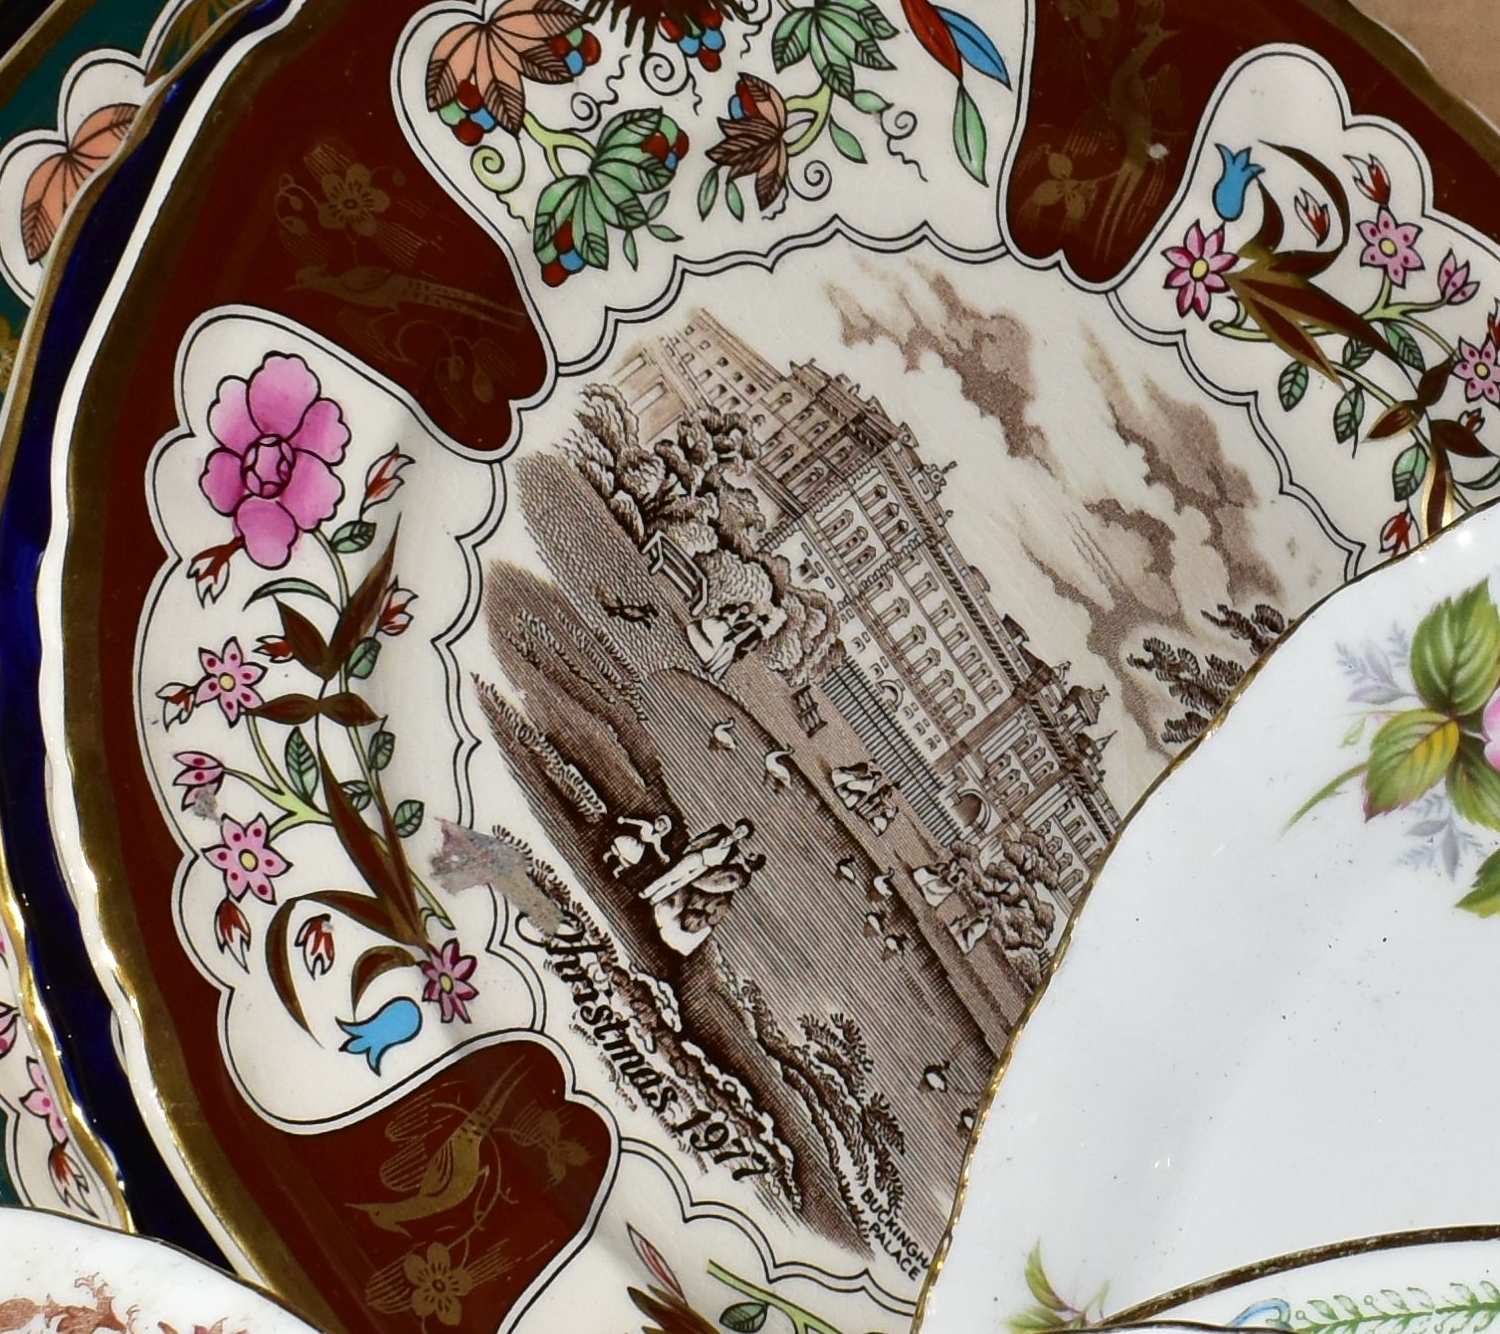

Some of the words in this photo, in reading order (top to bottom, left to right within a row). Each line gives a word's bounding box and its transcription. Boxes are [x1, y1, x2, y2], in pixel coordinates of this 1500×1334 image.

[515, 912, 680, 1117] Christmas
[671, 1110, 770, 1182] 1977
[860, 1187, 930, 1270] BUCKINGH
[869, 1222, 921, 1282] PALACE
